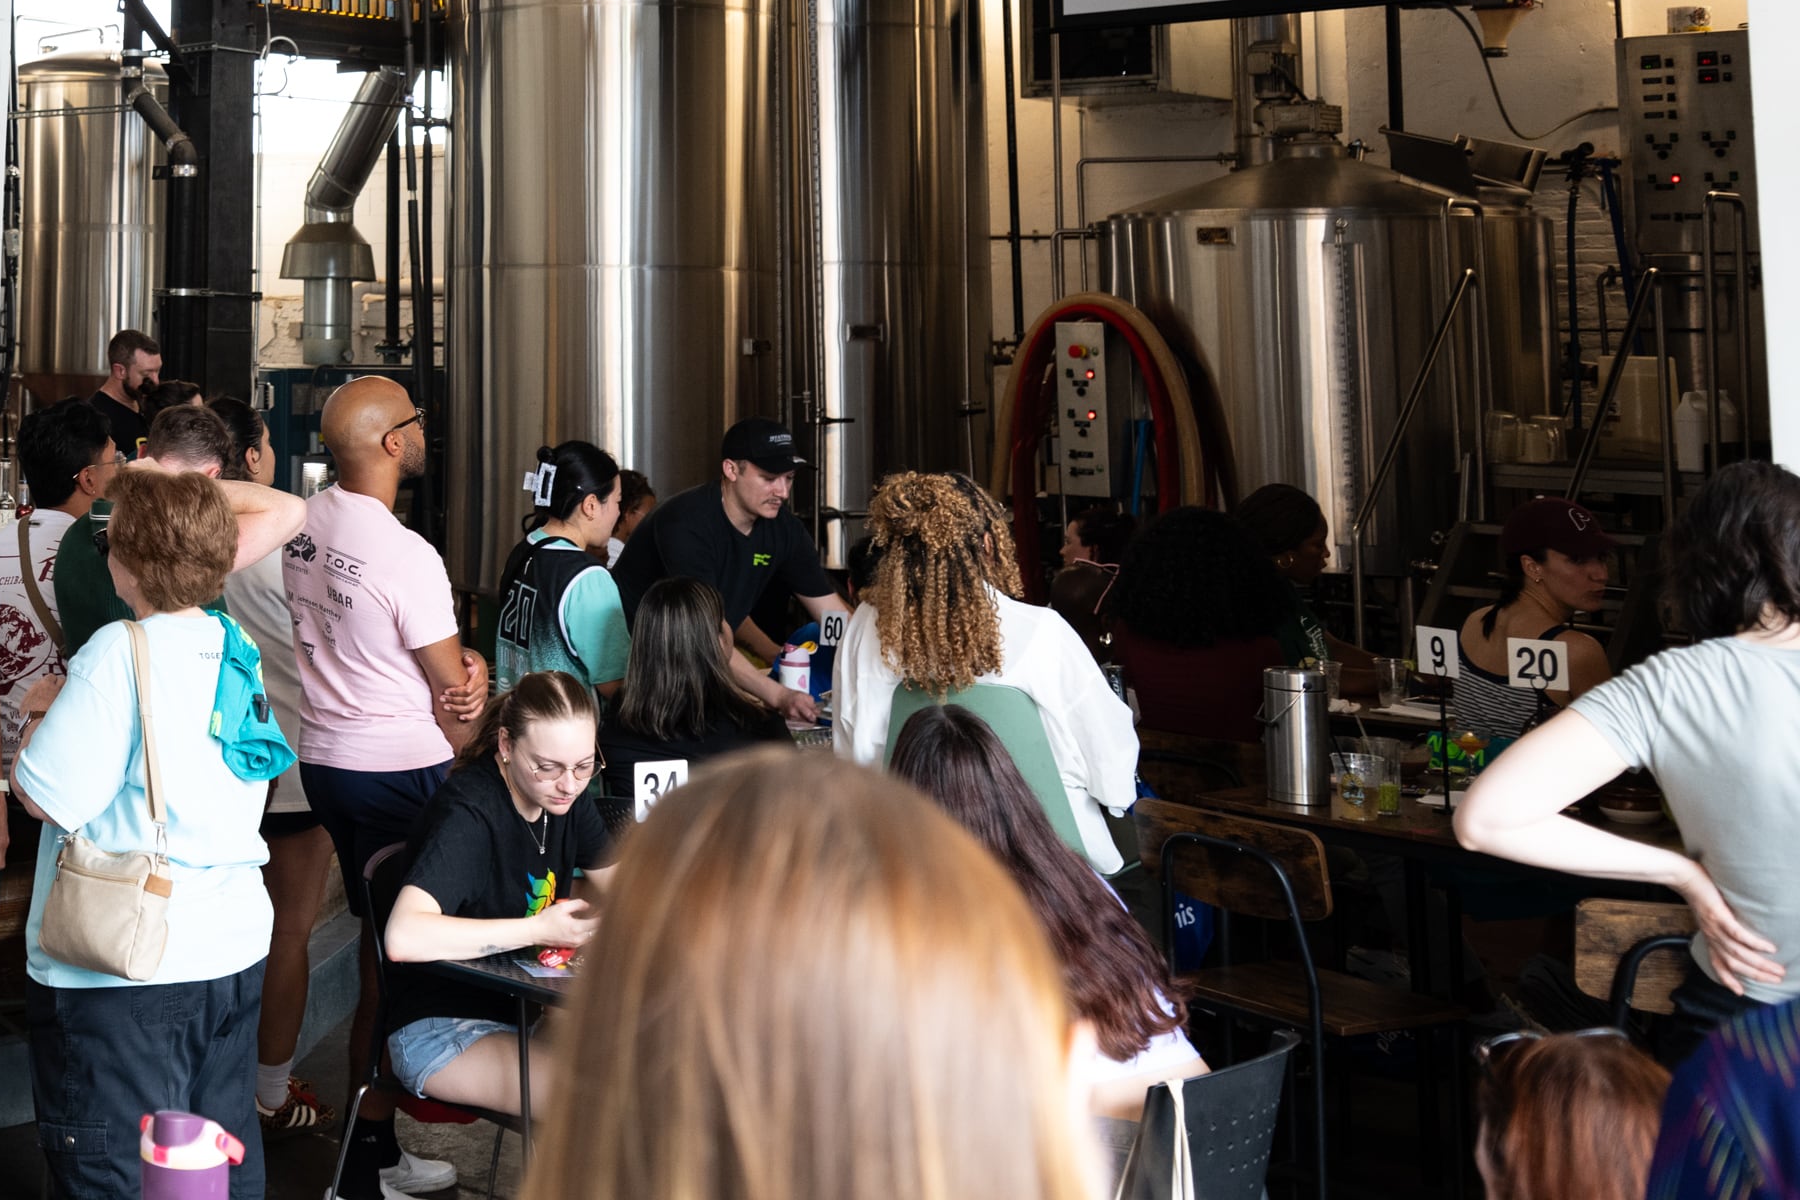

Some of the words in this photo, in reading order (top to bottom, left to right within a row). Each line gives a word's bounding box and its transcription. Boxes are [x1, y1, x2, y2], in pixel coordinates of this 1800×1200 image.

[325, 553, 362, 578] T.O.C.
[326, 584, 353, 610] UBAR
[499, 580, 538, 653] 20
[824, 616, 843, 641] 60
[1430, 636, 1446, 667] 9
[1516, 647, 1558, 682] 20
